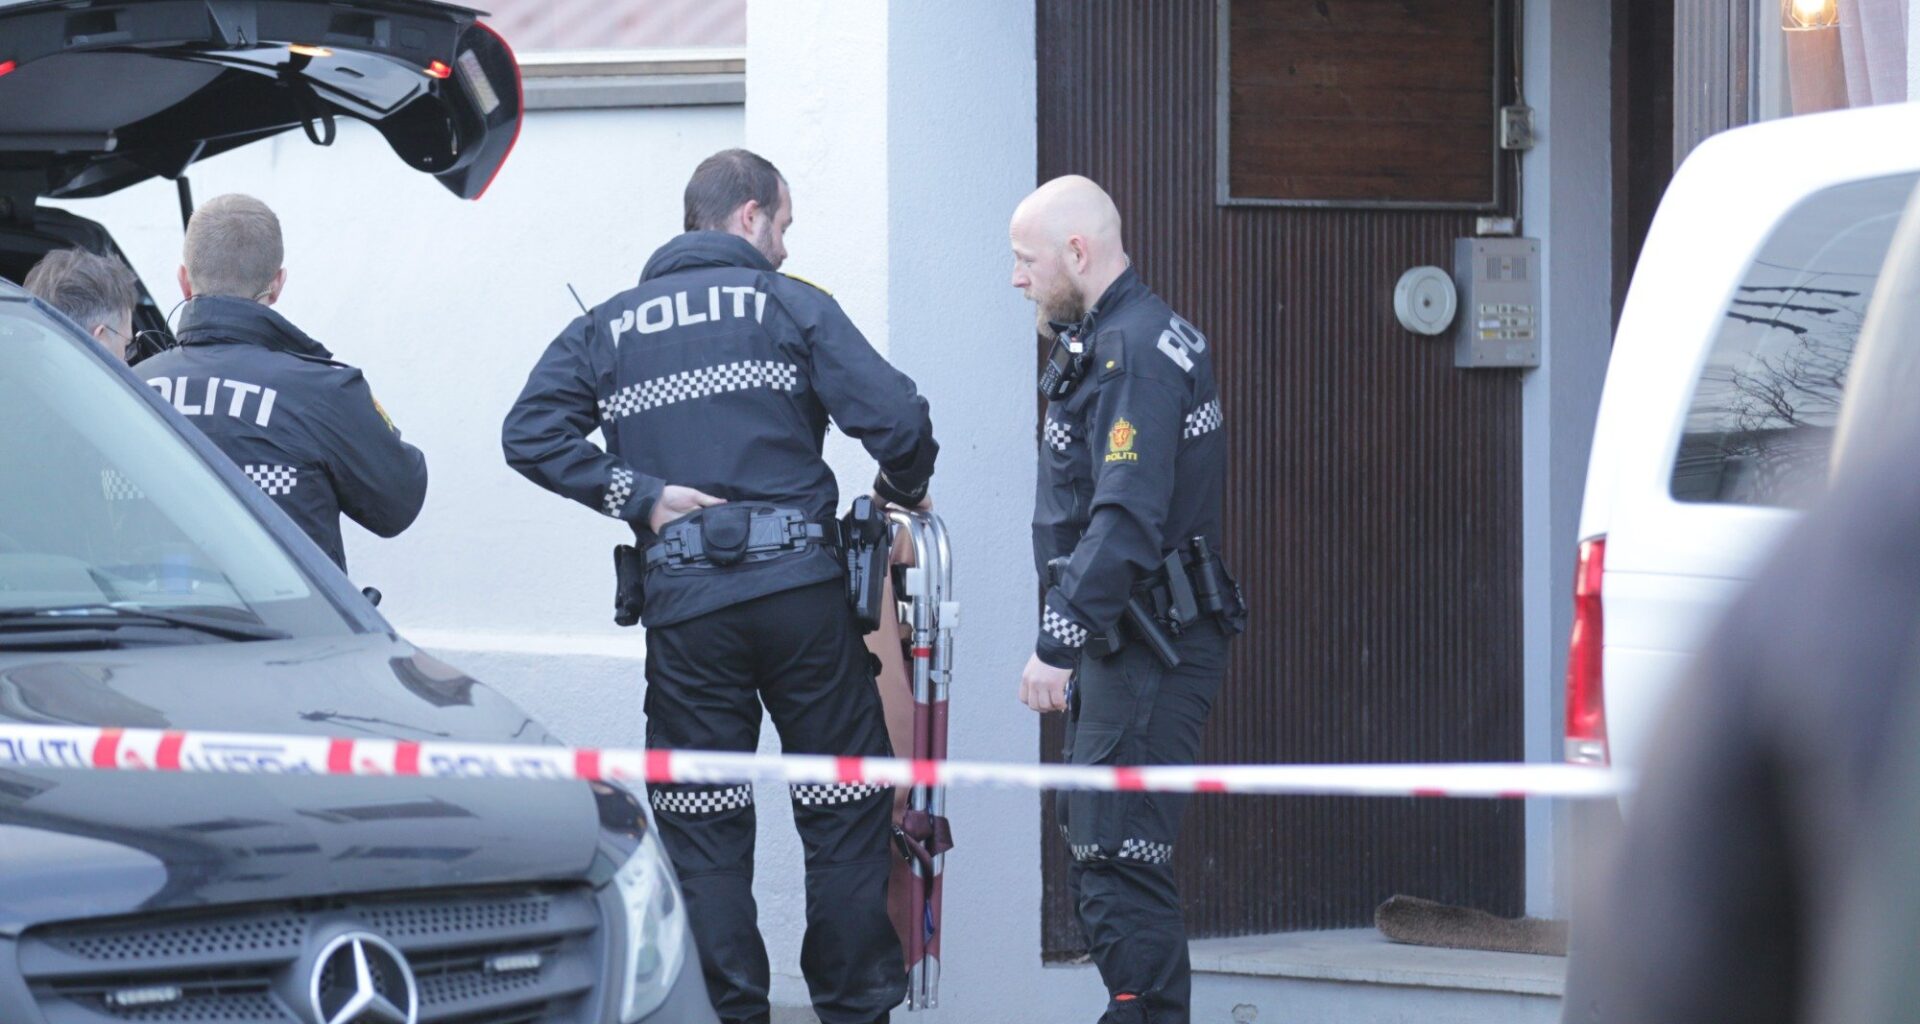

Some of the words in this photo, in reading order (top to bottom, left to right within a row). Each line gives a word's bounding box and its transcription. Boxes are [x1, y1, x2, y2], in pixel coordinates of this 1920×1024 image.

[609, 285, 767, 349] POLITI
[1156, 316, 1206, 373] PO
[145, 376, 278, 428] OLITI
